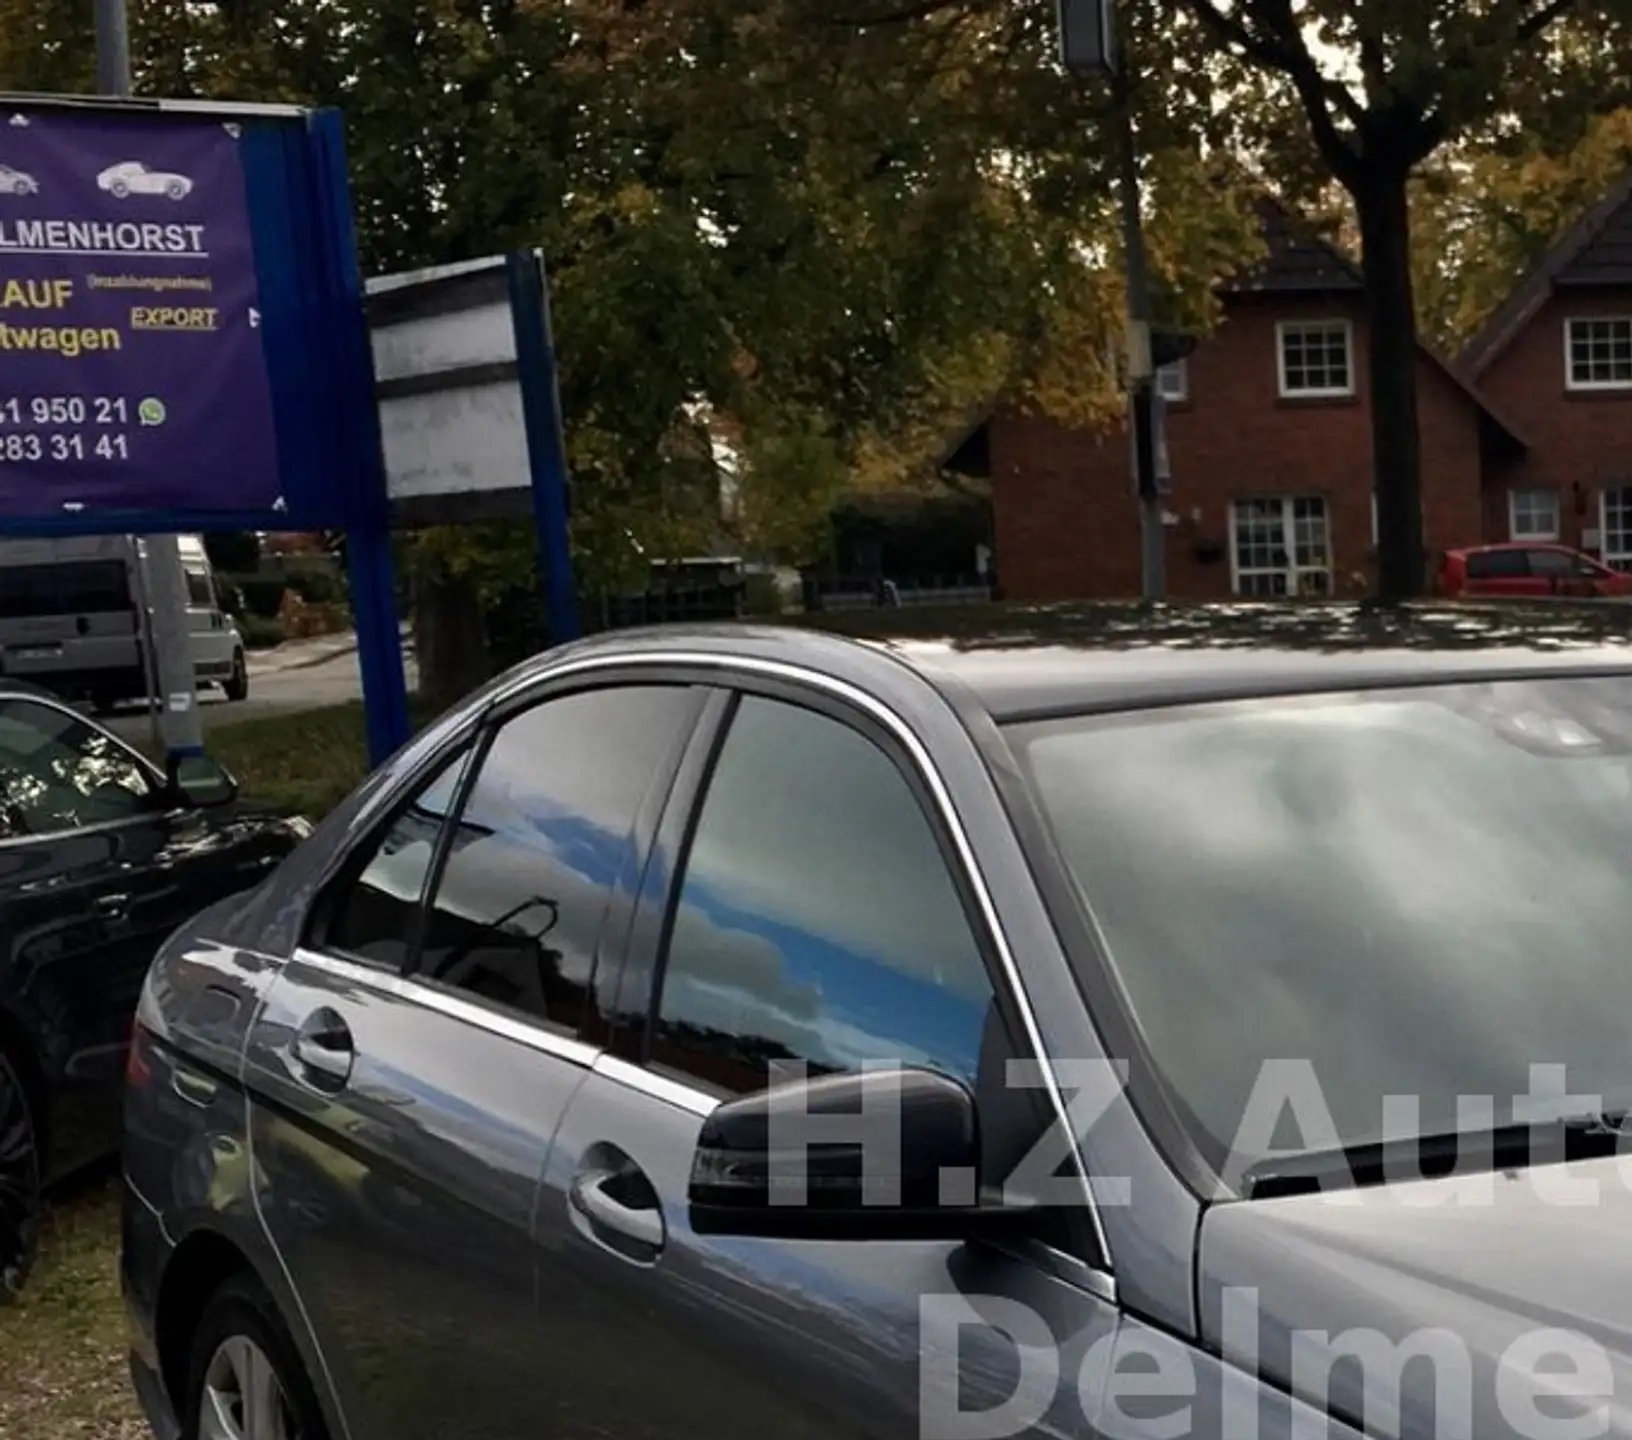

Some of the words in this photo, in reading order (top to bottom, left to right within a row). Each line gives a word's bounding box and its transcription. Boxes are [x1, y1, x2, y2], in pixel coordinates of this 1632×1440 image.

[0, 279, 73, 308] AUF
[131, 306, 218, 328] EXPORT
[0, 397, 21, 424] 1
[30, 397, 86, 424] 950
[94, 397, 128, 423] 21
[51, 433, 84, 460] 31
[95, 433, 128, 460] 41
